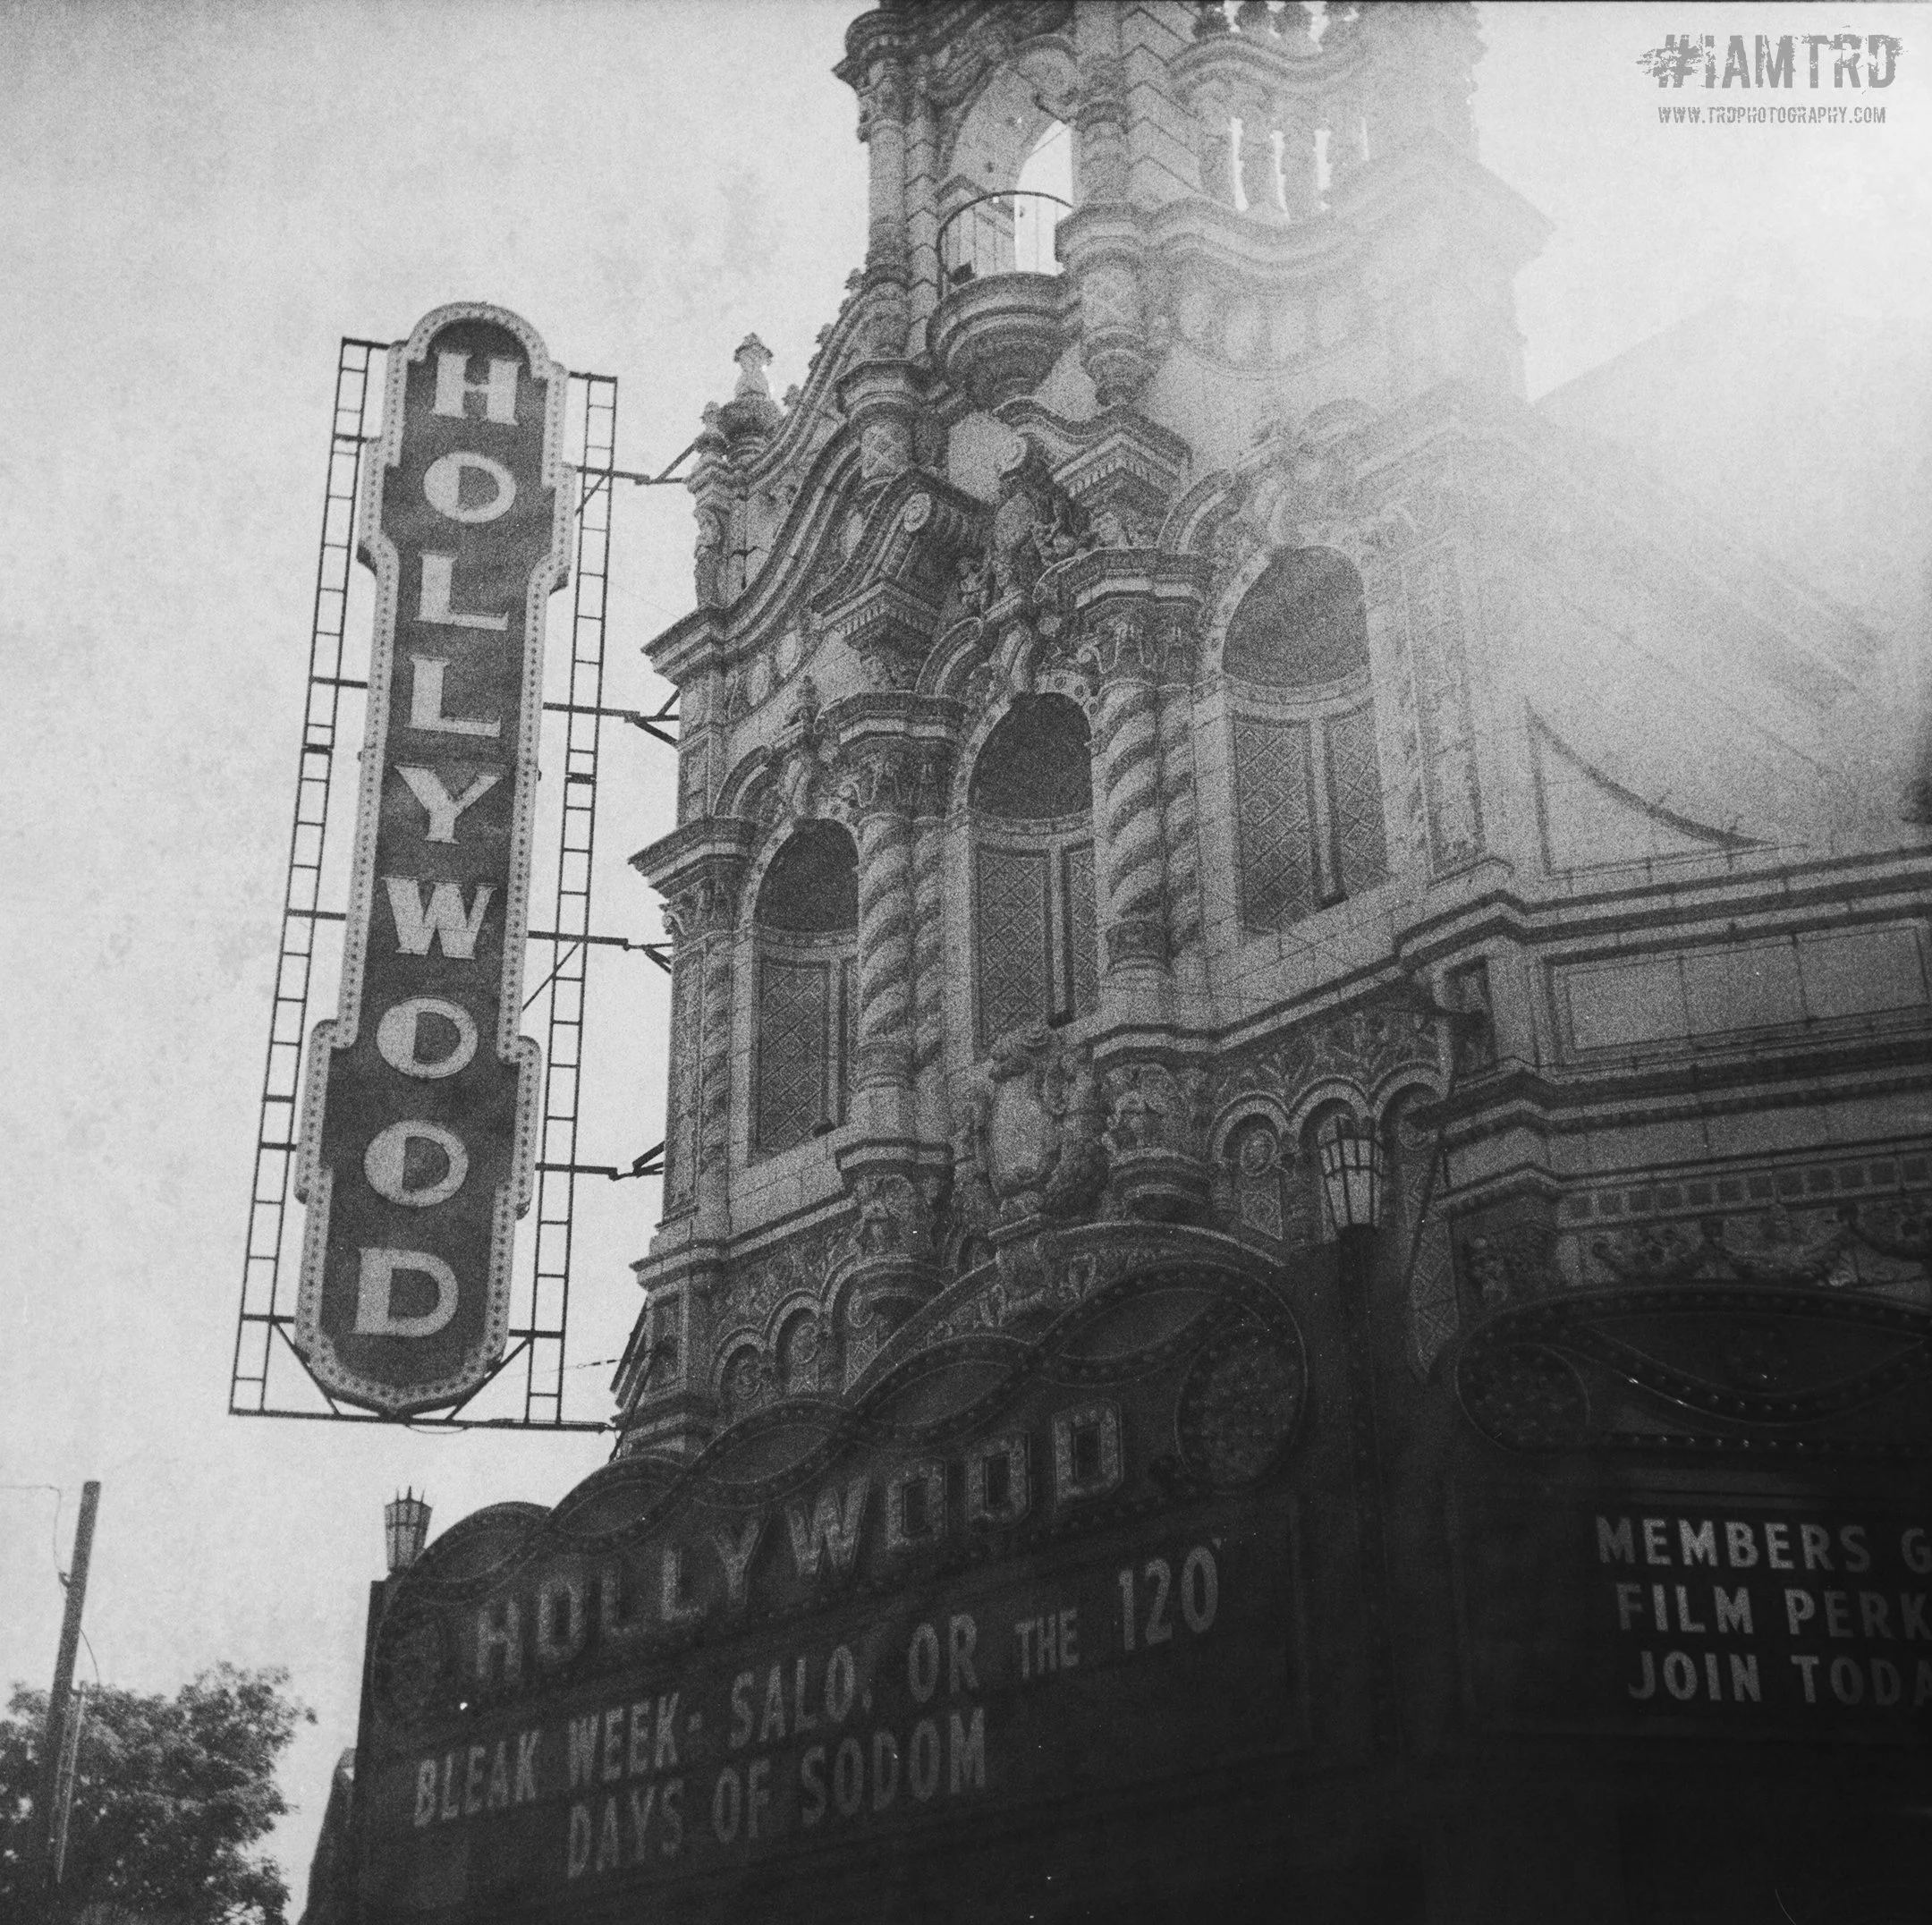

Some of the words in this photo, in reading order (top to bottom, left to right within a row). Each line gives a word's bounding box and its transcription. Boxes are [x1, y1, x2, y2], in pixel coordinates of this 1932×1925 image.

[353, 352, 522, 1338] HOLLYWOOD
[476, 1400, 1121, 1683] HOLLYWOOD
[1596, 1518, 1871, 1573] MEMBERS
[1615, 1583, 1754, 1635] FILM
[1784, 1588, 1932, 1641] PERK
[414, 1730, 538, 1827] BLEAK
[908, 1614, 979, 1703] OR
[1014, 1609, 1080, 1681] THE
[1628, 1650, 1762, 1703] JOIN
[567, 1777, 684, 1879] DAYS
[714, 1758, 770, 1844] OF
[801, 1707, 985, 1828] SODOM
